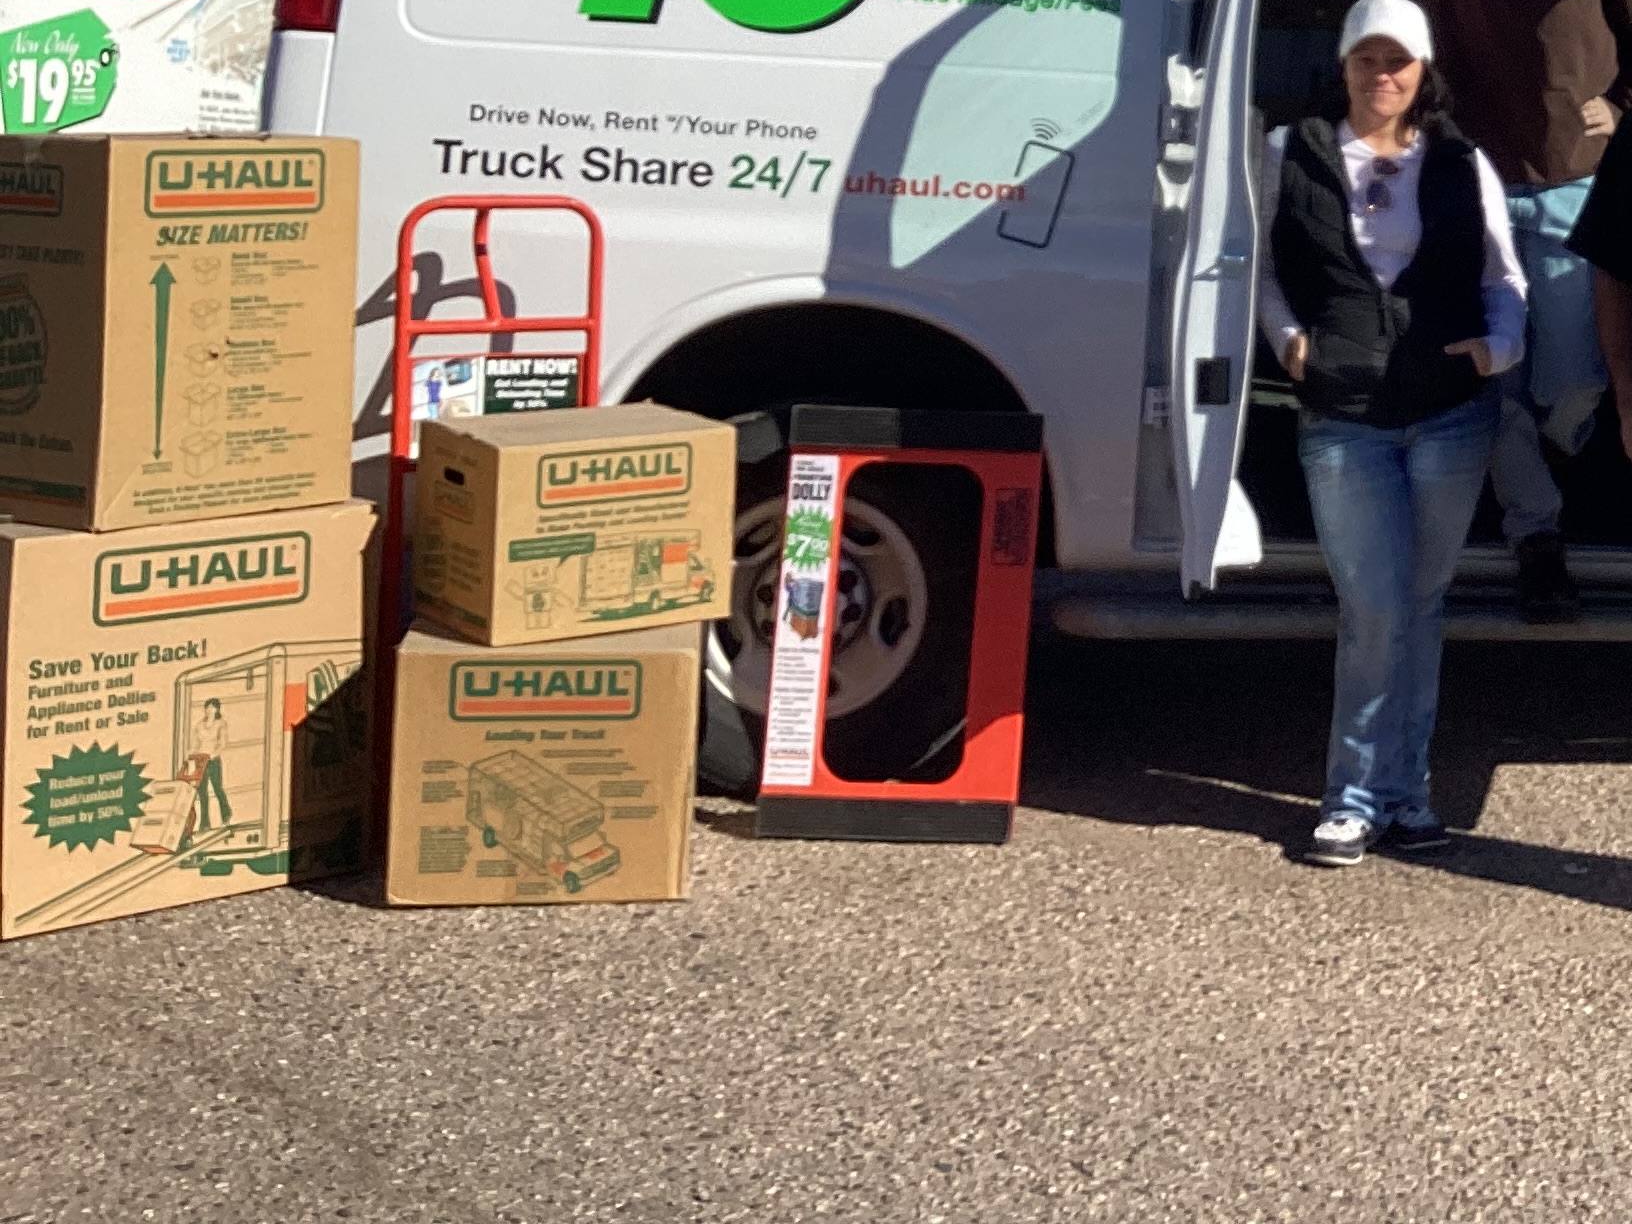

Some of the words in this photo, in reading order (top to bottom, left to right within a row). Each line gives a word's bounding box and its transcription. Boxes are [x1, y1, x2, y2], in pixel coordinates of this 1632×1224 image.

[470, 104, 529, 125] Drive
[537, 107, 597, 130] Now,
[605, 111, 658, 132] Rent
[745, 119, 818, 141] Phone
[159, 159, 313, 191] U-HAUL
[432, 137, 565, 180] Truck
[581, 146, 714, 187] Share
[728, 150, 832, 198] 24/7
[843, 169, 1026, 201] uhaul.com
[157, 225, 202, 247] SIZE
[207, 222, 309, 244] MATTERS!
[486, 359, 532, 376] RENT
[549, 451, 682, 486] U-HAUL
[792, 482, 831, 501] DOLLY
[110, 545, 297, 595] U-HAUL
[29, 659, 83, 680] Save
[91, 651, 139, 672] Your
[147, 638, 208, 665] Back!
[28, 680, 100, 700] Furniture
[106, 673, 133, 690] and
[463, 670, 629, 697] U-HAUL
[27, 699, 102, 721] Appliance
[108, 690, 157, 709] Dollies
[26, 725, 49, 739] for
[55, 717, 90, 735] Rent
[96, 716, 111, 729] or
[117, 710, 149, 727] Sale
